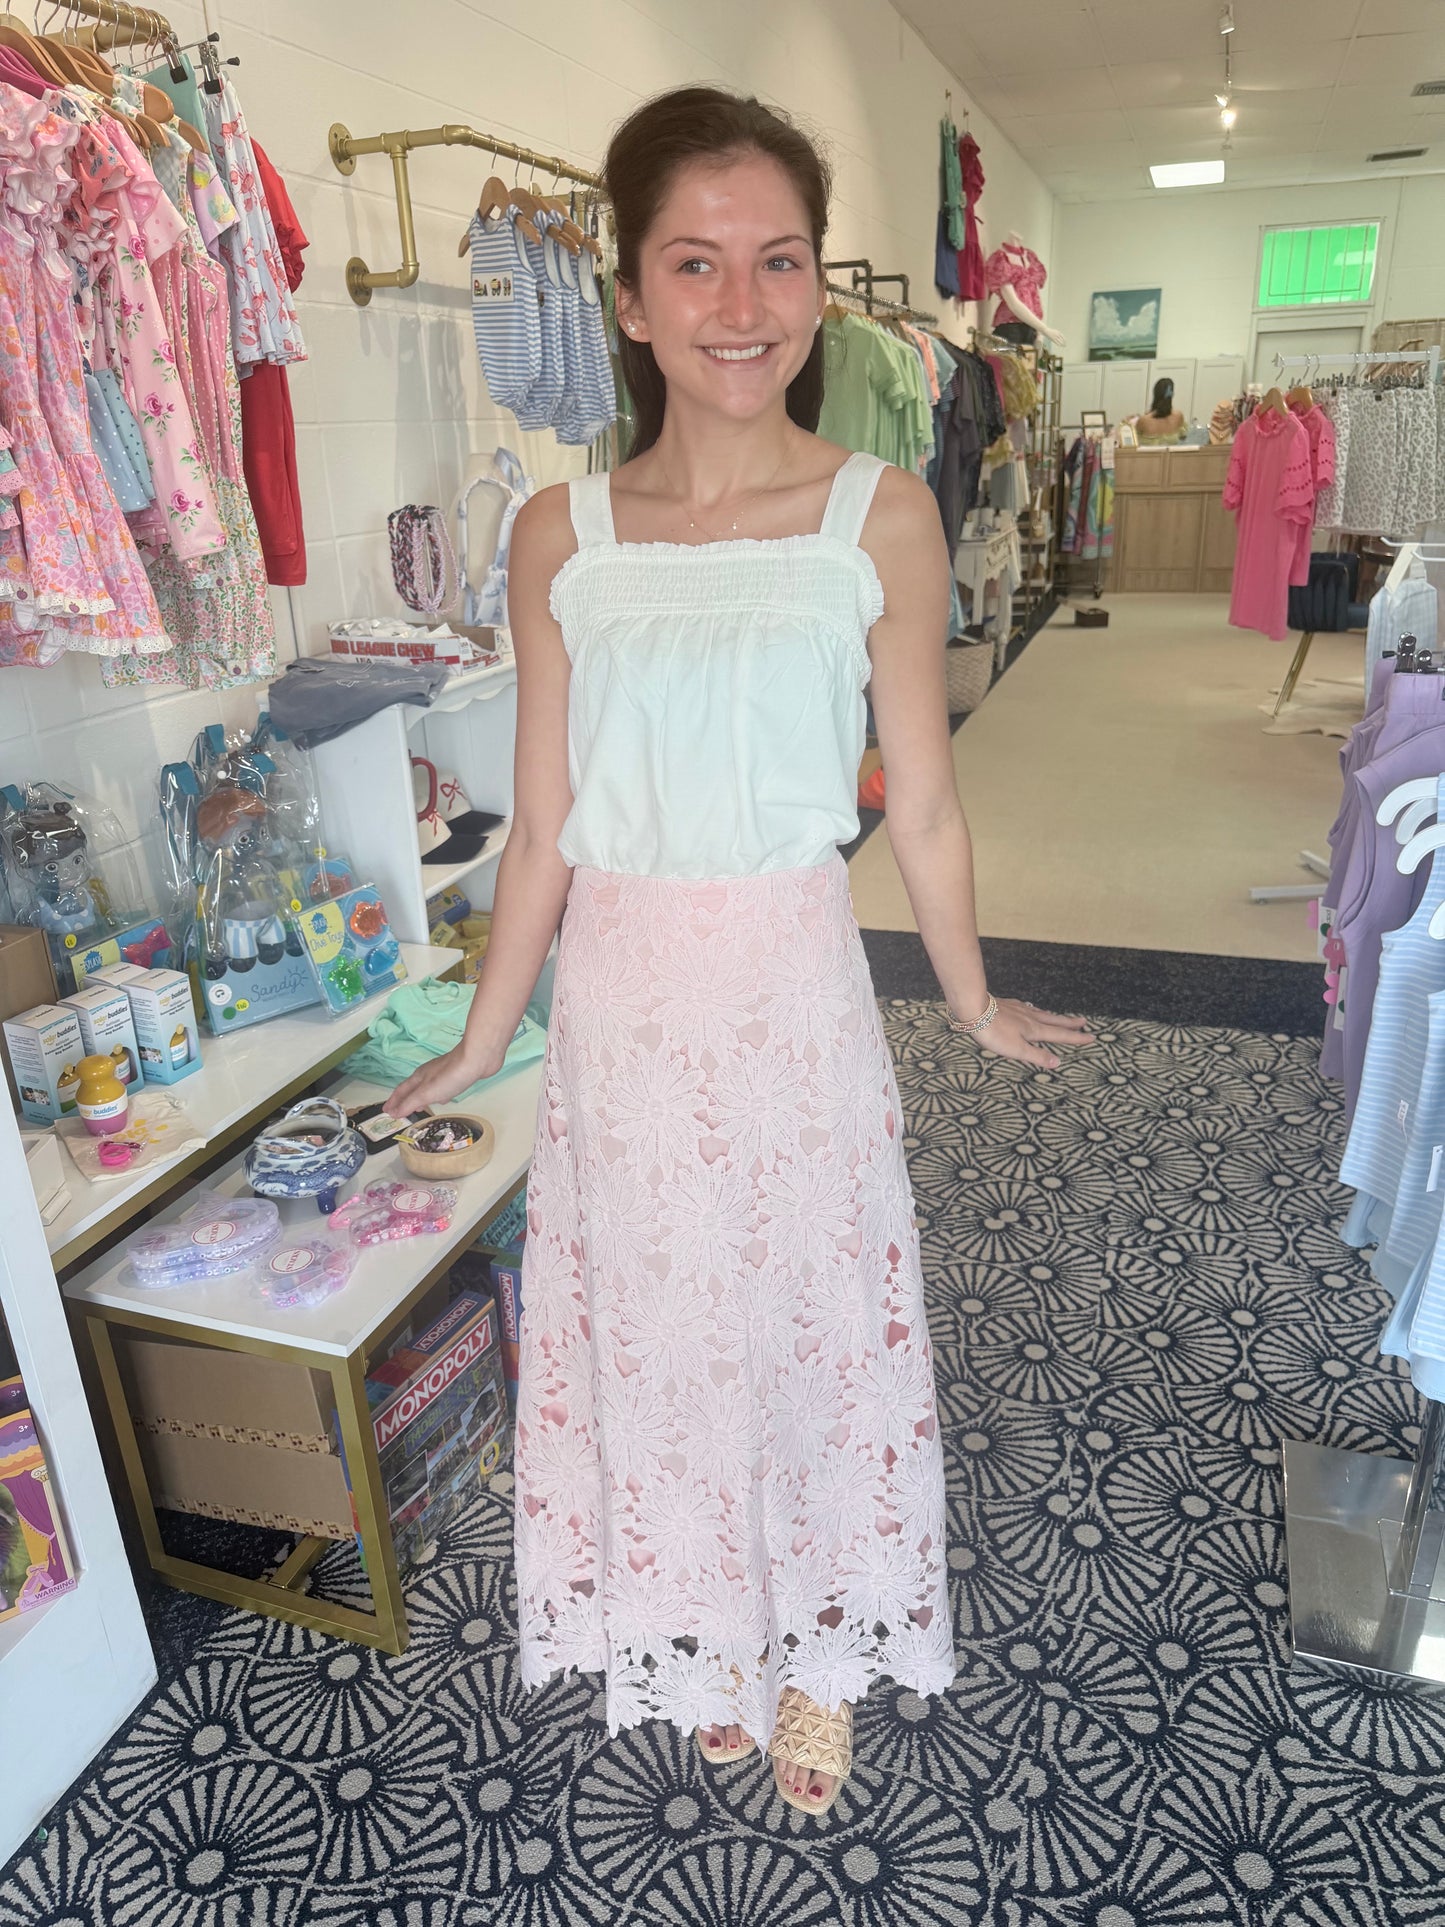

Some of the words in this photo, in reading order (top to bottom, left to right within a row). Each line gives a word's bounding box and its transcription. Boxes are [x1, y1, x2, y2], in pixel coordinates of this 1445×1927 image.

[350, 640, 397, 657] LEAGUE
[397, 642, 436, 658] CHEW
[250, 972, 302, 1003] Sandy
[107, 1006, 128, 1019] buddies
[56, 1023, 77, 1038] buddies
[93, 1105, 118, 1115] buddies
[501, 1274, 516, 1339] MONOPOLY
[421, 1300, 472, 1350] MONOPOLY
[380, 1322, 488, 1443] MONOPOLY
[18, 1424, 29, 1433] 3+
[35, 1578, 75, 1600] WARNING
